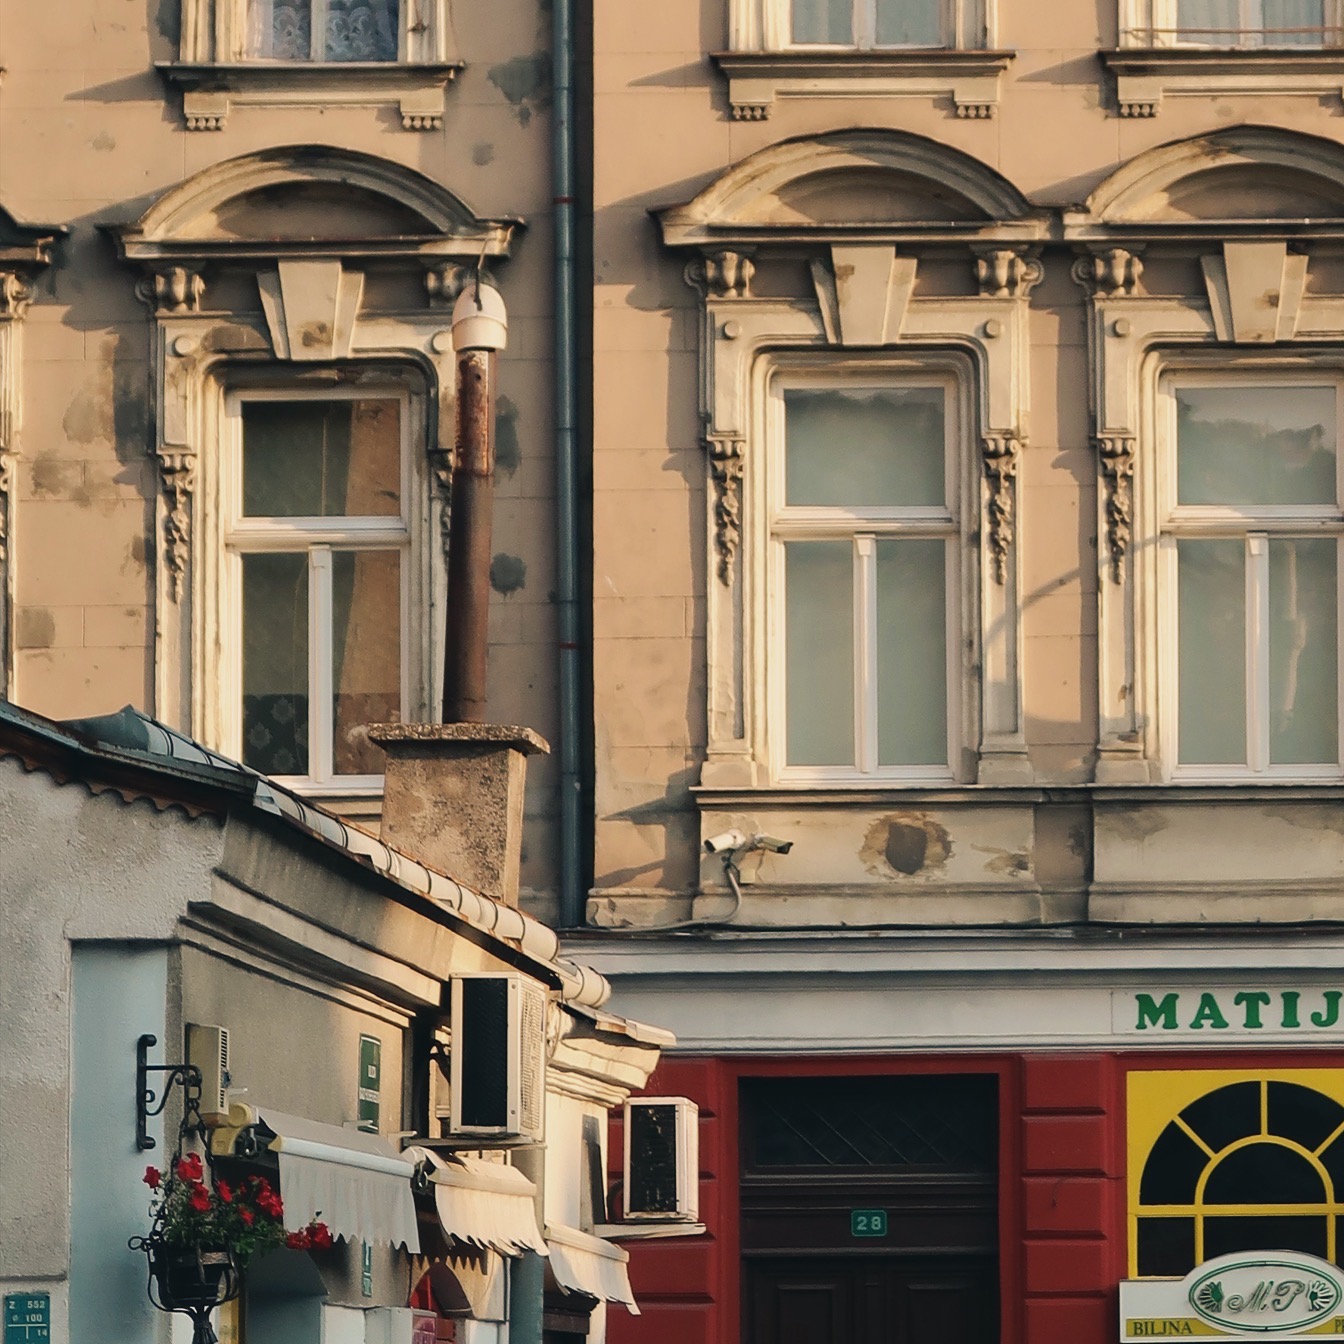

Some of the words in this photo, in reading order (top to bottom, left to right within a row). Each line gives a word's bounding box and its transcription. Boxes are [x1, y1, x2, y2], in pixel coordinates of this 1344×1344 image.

[856, 1216, 881, 1230] 28
[9, 1300, 15, 1310] Z
[27, 1300, 45, 1309] 552
[26, 1314, 43, 1322] 100
[1132, 1321, 1193, 1335] BILJNA
